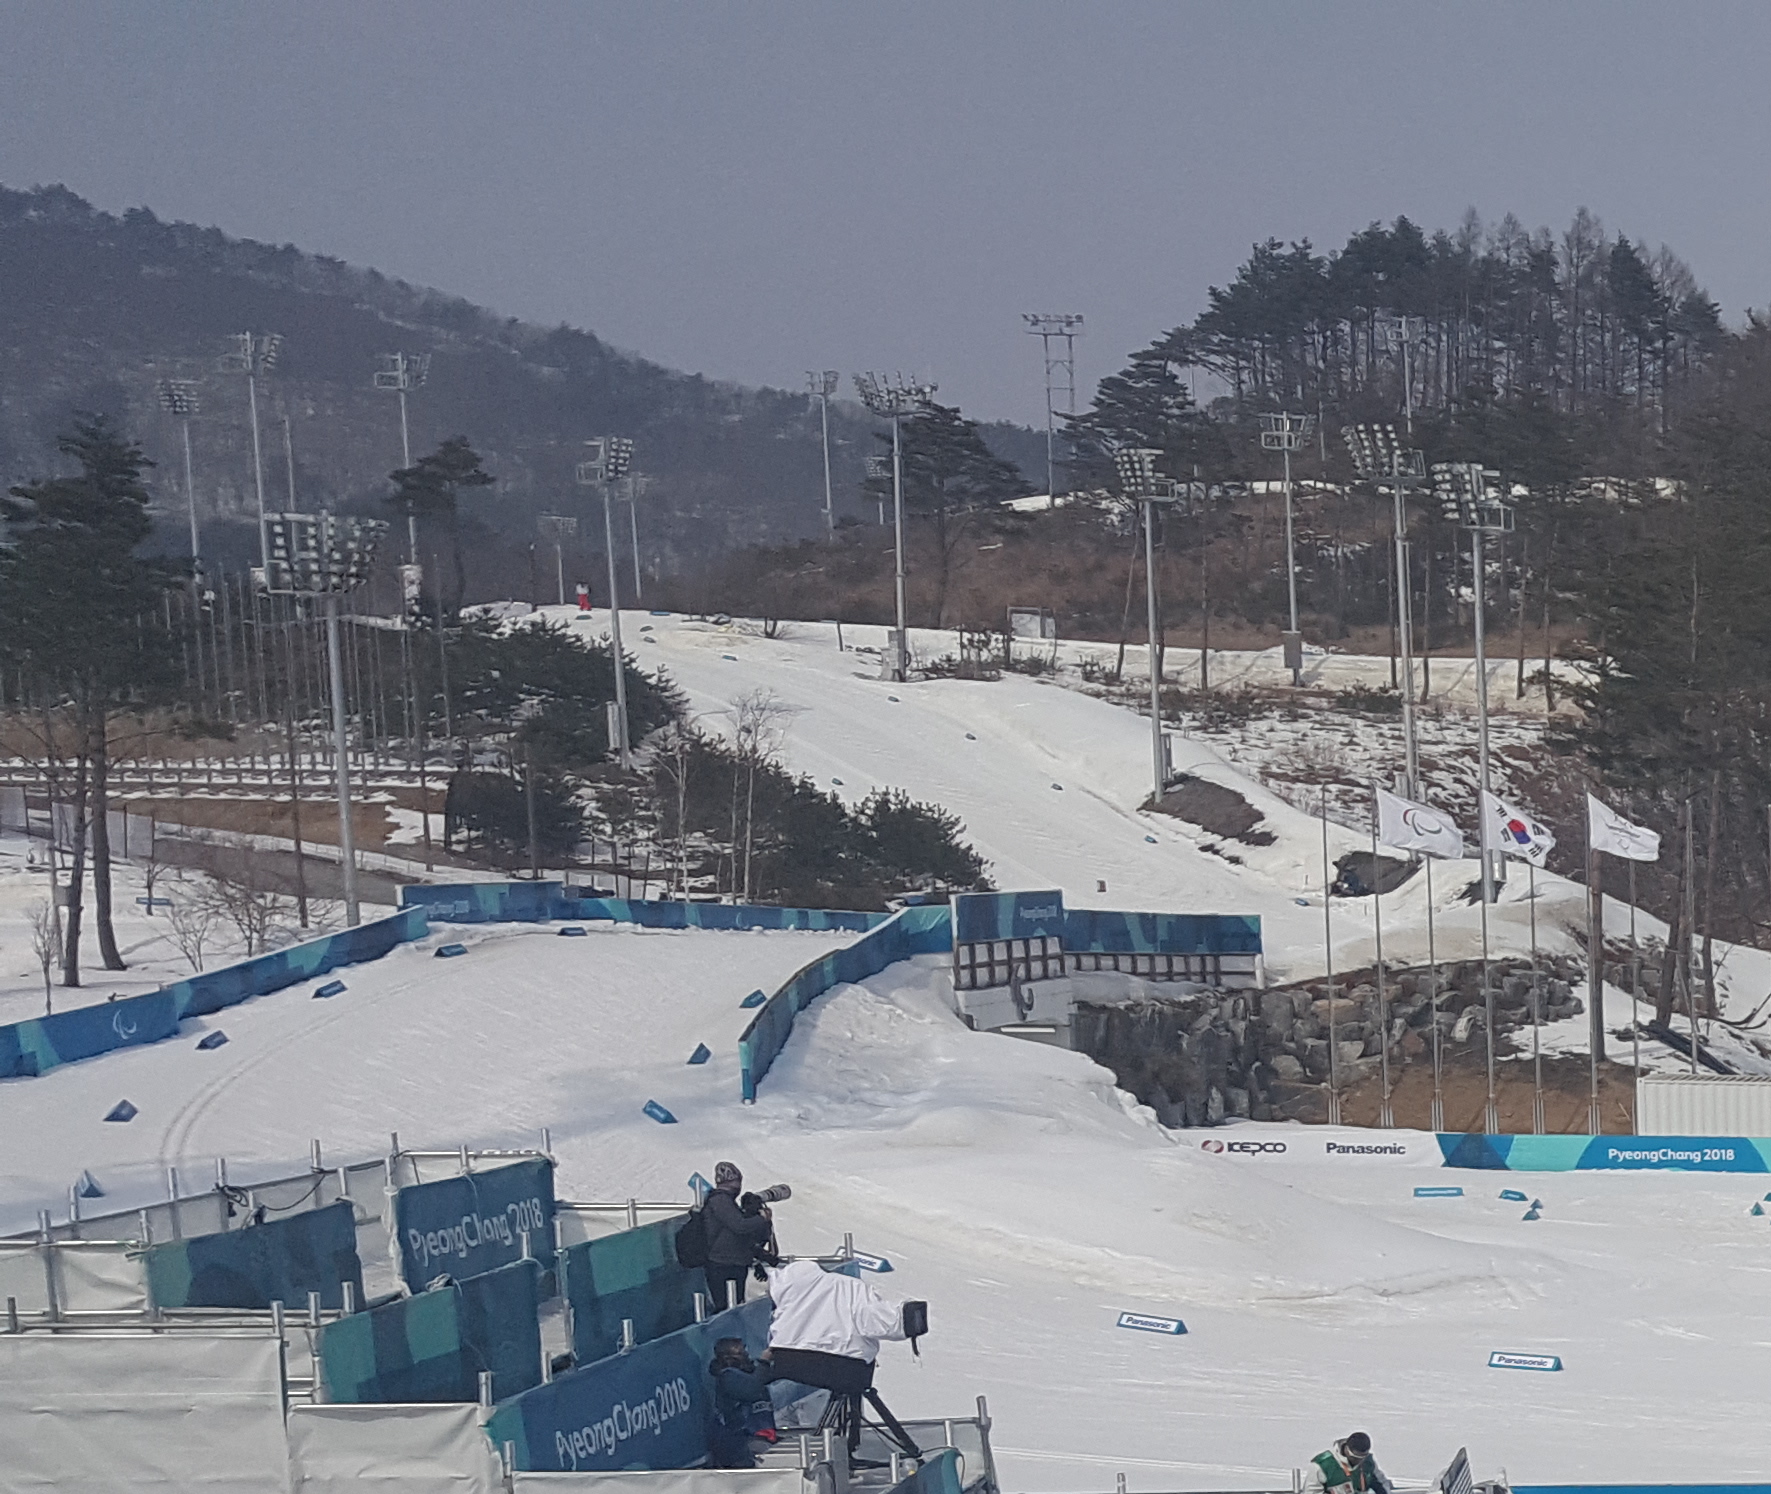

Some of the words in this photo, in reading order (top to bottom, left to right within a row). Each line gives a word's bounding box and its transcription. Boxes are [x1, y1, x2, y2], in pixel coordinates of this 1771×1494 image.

[1325, 1141, 1406, 1156] Panasonic
[1608, 1148, 1700, 1163] PyeongChang
[1702, 1148, 1735, 1161] 2018
[409, 1212, 513, 1268] PyeongChang
[507, 1197, 545, 1240] 2018
[1125, 1315, 1171, 1330] Panasonic
[1497, 1355, 1547, 1368] Panasonic
[555, 1400, 662, 1471] PyeongChang
[654, 1377, 691, 1423] 2018
